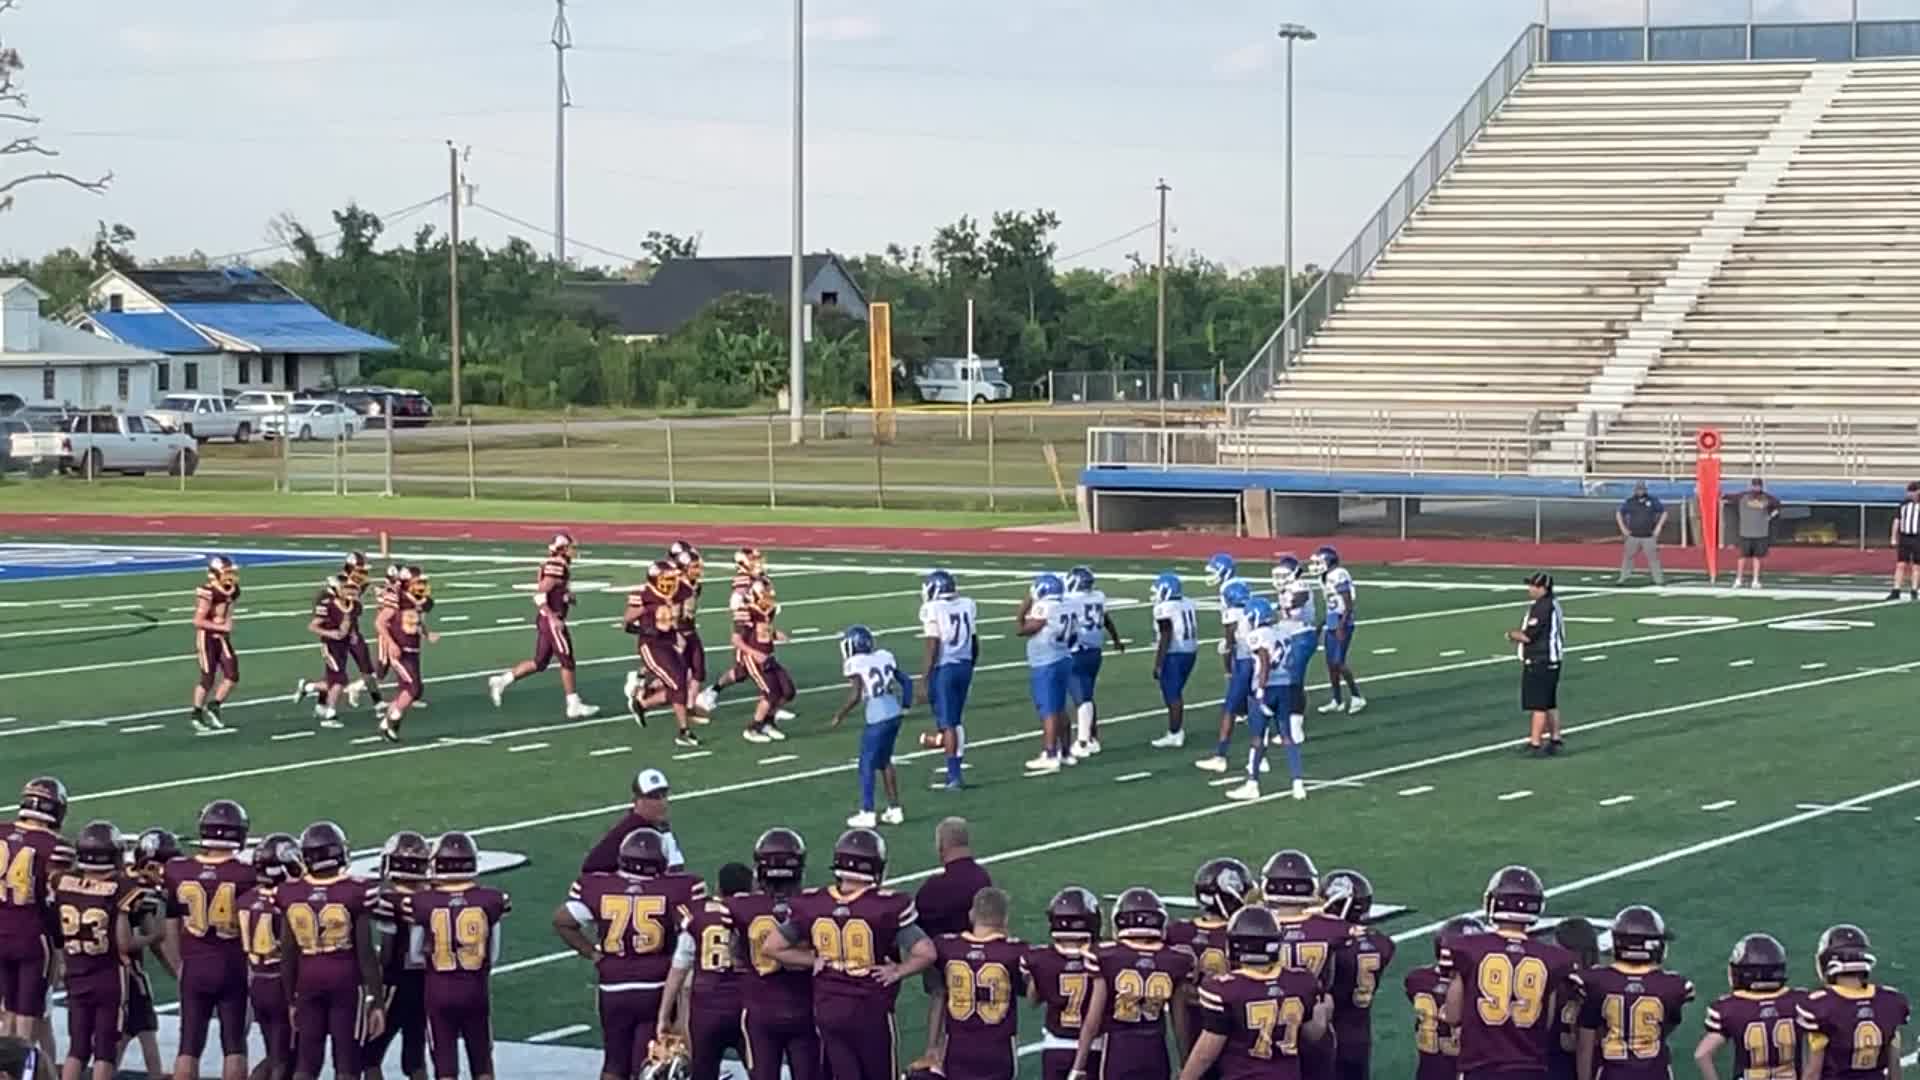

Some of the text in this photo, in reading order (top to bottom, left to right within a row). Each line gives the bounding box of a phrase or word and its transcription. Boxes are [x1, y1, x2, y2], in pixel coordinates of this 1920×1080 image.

[176, 879, 242, 938] 34
[430, 906, 489, 972] 19
[600, 894, 667, 956] 75
[1059, 972, 1089, 1029] 7
[1477, 953, 1548, 1028] 99
[1602, 994, 1665, 1060] 16
